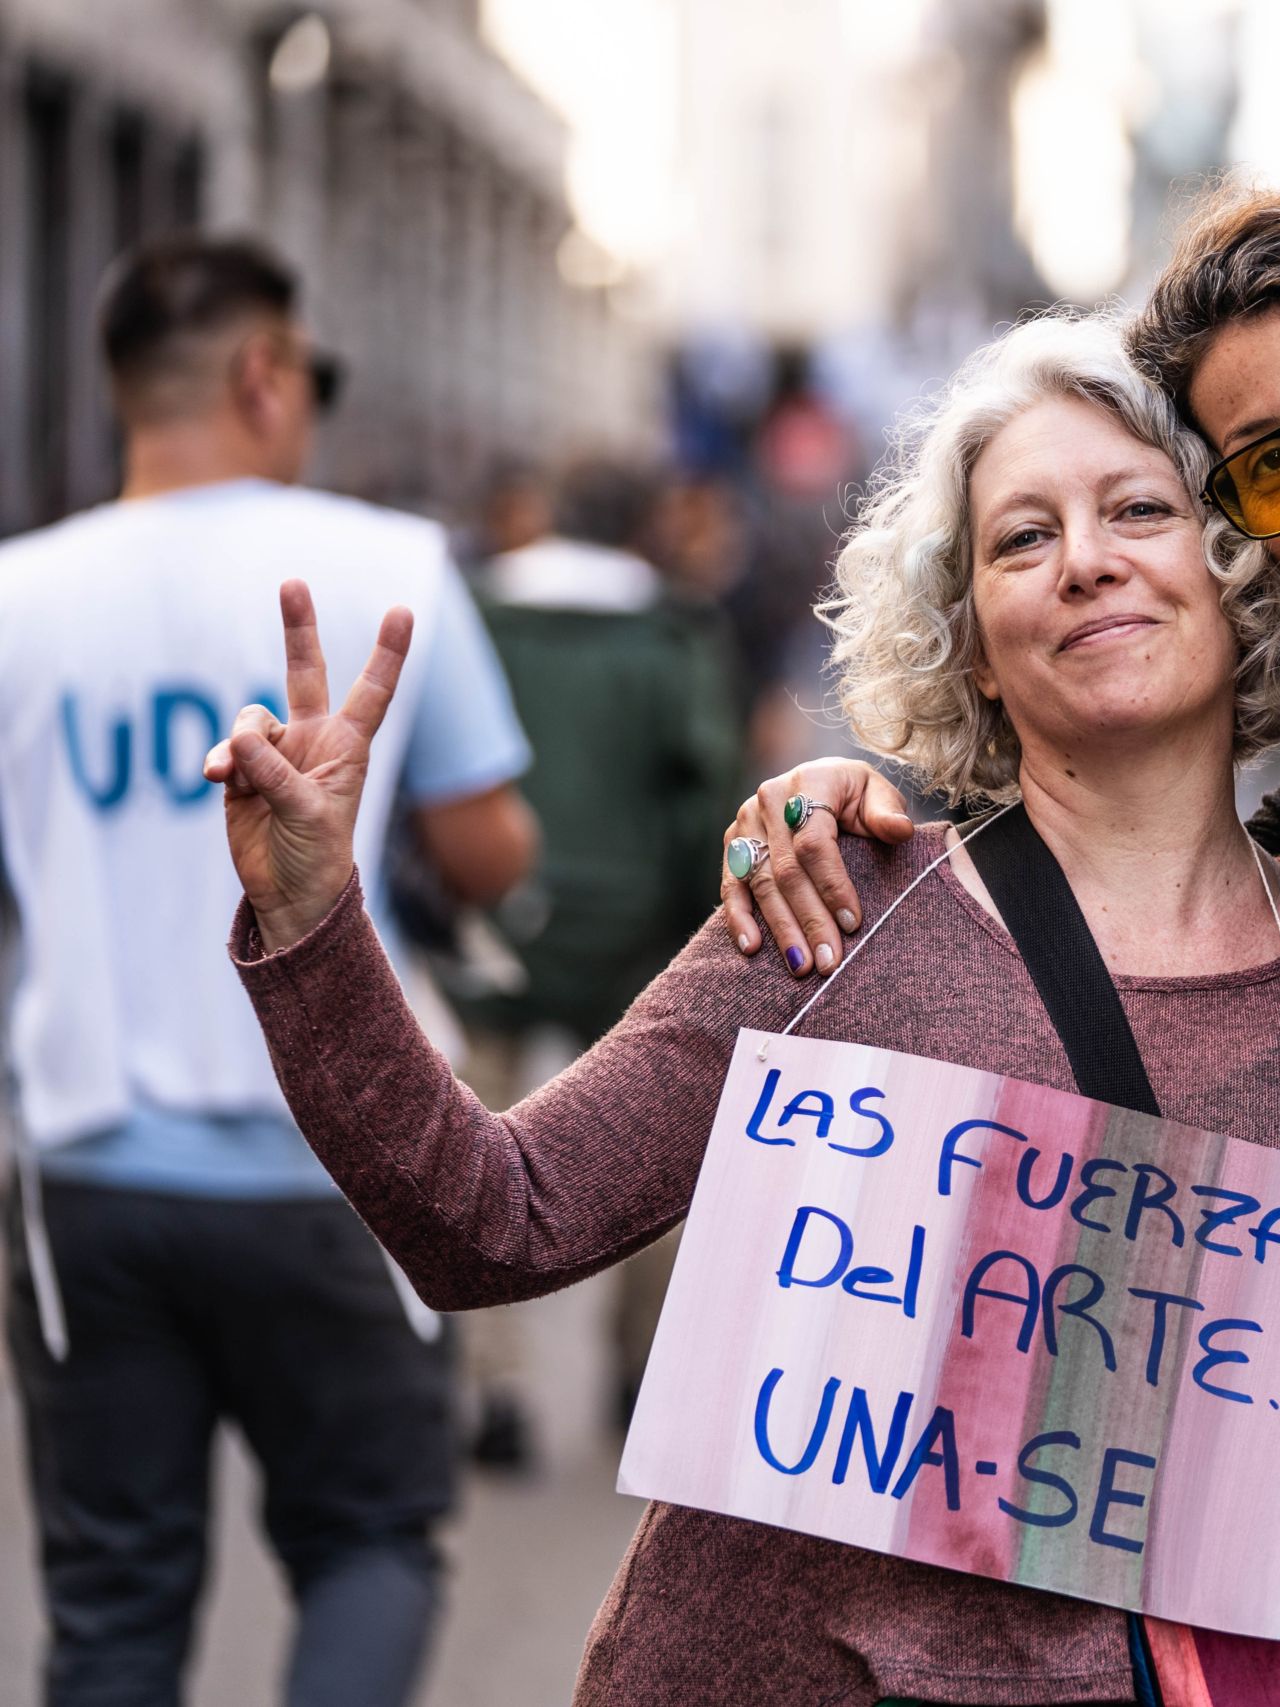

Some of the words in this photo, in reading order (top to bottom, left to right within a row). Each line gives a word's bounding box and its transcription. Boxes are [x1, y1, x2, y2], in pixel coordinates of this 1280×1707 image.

[60, 683, 288, 813] UD
[746, 1069, 895, 1158] LAS
[776, 1206, 926, 1319] Del
[754, 1367, 1157, 1554] UNA-SE
